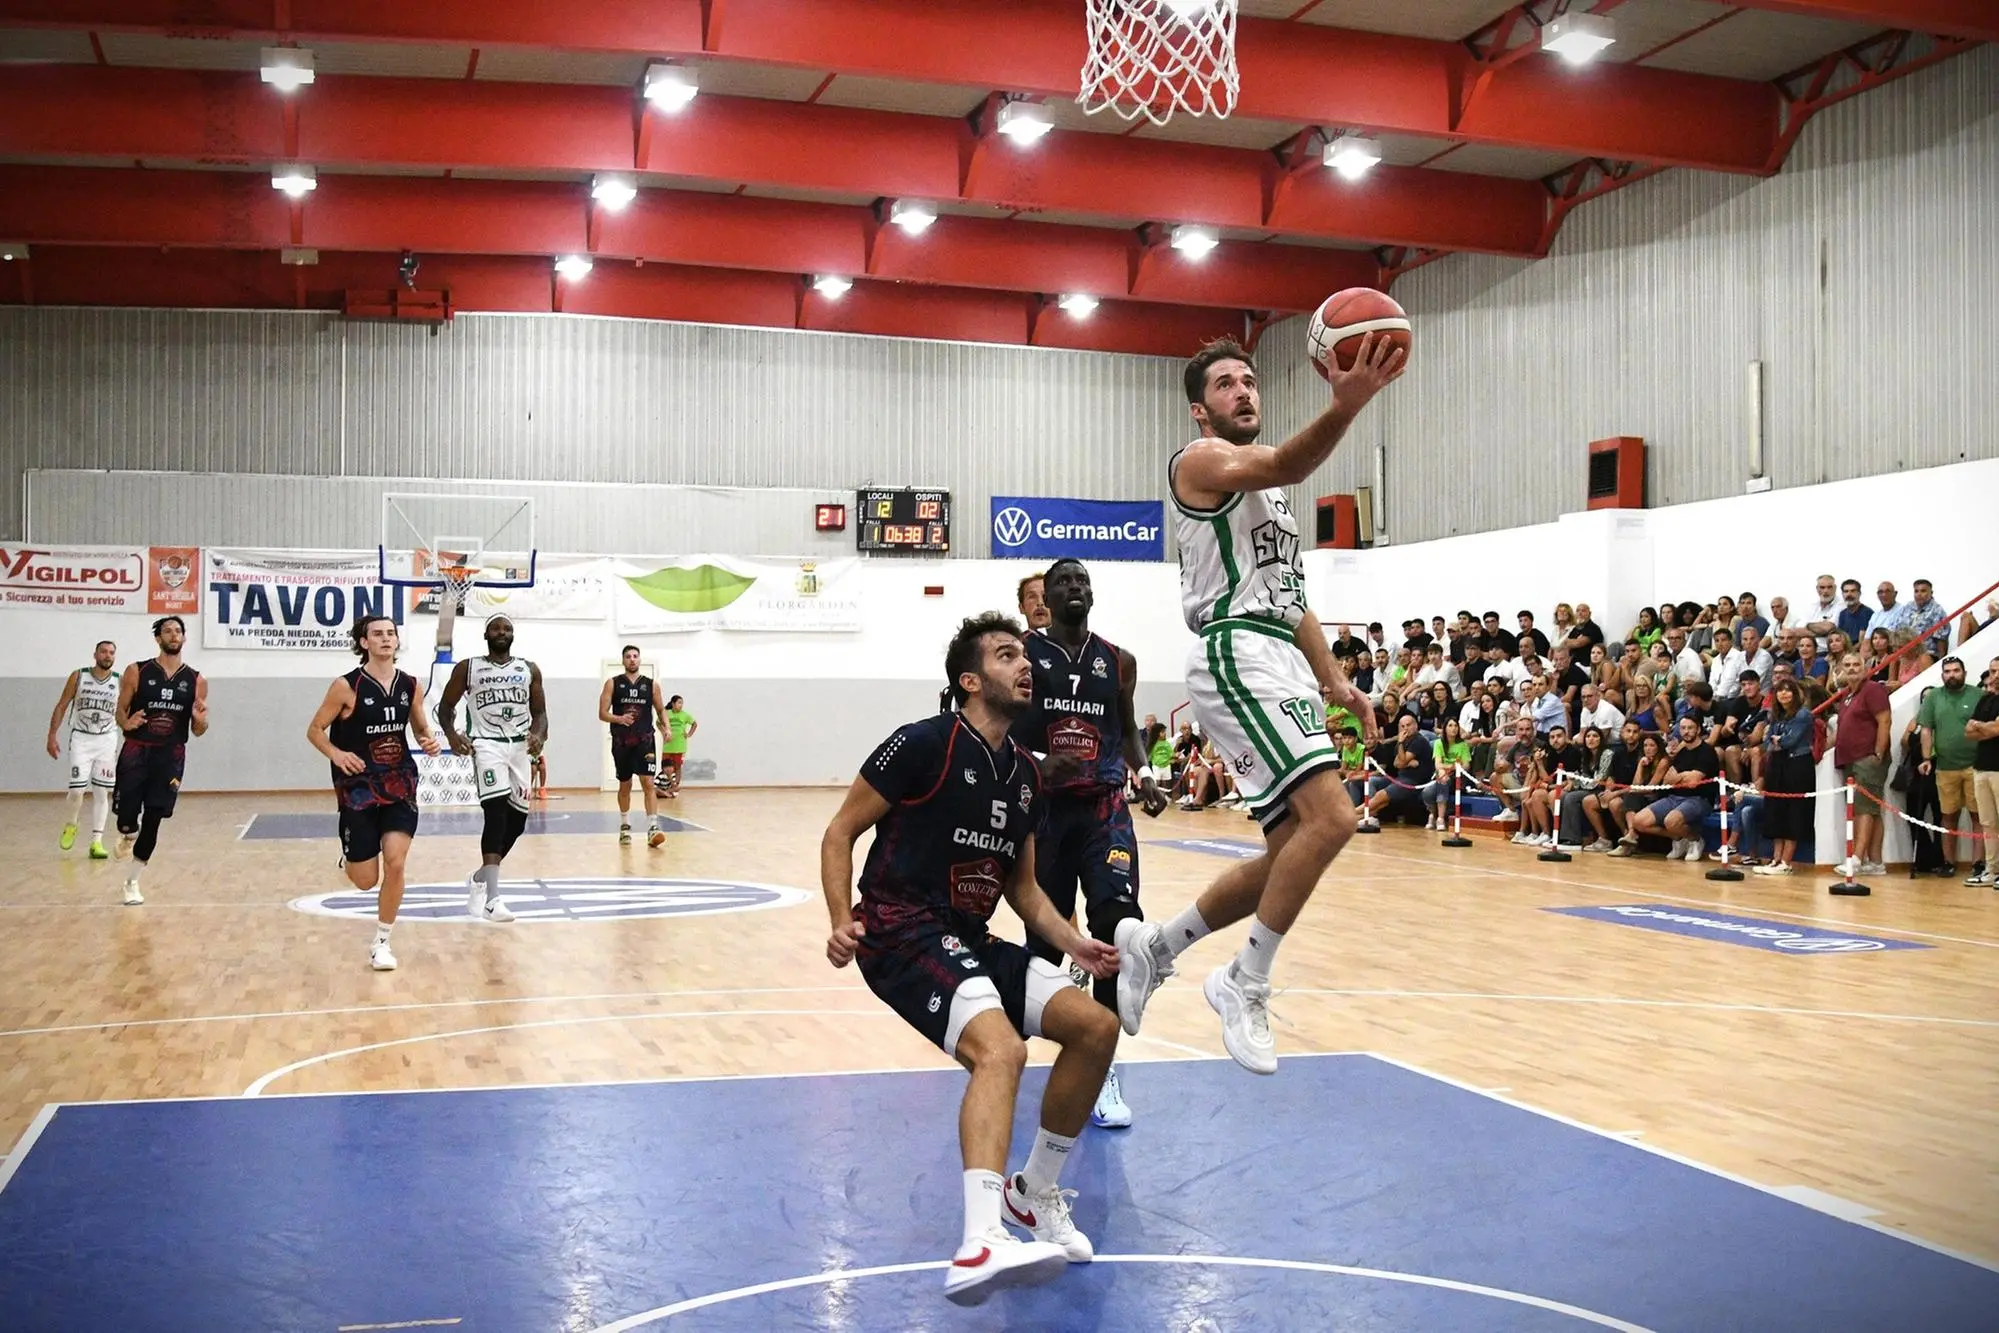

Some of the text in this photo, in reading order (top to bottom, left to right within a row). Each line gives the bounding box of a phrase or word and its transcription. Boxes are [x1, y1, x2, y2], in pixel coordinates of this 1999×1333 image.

[867, 492, 894, 500] LOCALI
[915, 493, 942, 501] OSPITI
[818, 508, 843, 526] 21
[877, 501, 890, 517] 12
[919, 502, 938, 518] 02
[932, 527, 942, 543] 2
[1036, 519, 1159, 541] GermanCar
[211, 572, 272, 584] TRATTAMENTO
[274, 576, 280, 584] E
[280, 576, 332, 585] TRASPORTO
[334, 575, 364, 585] RIFIUTI
[6, 592, 53, 604] Sicurezza
[56, 595, 65, 604] al
[68, 595, 84, 605] tuo
[87, 596, 125, 606] servizio
[209, 582, 404, 626] TAVONI
[229, 628, 245, 637] VIA
[247, 629, 285, 637] PREDDA
[327, 630, 337, 638] 12
[261, 638, 297, 647] Tel./Fax
[300, 639, 317, 648] 079
[629, 688, 638, 698] 10
[1067, 674, 1081, 696] 7
[161, 688, 174, 700] 99
[383, 706, 396, 721] 11
[1043, 698, 1105, 716] CAGLIARI
[1280, 697, 1328, 738] 12
[647, 763, 656, 772] 10
[482, 768, 498, 787] 9
[990, 799, 1008, 830] 5
[953, 827, 1016, 859] CAGLIA
